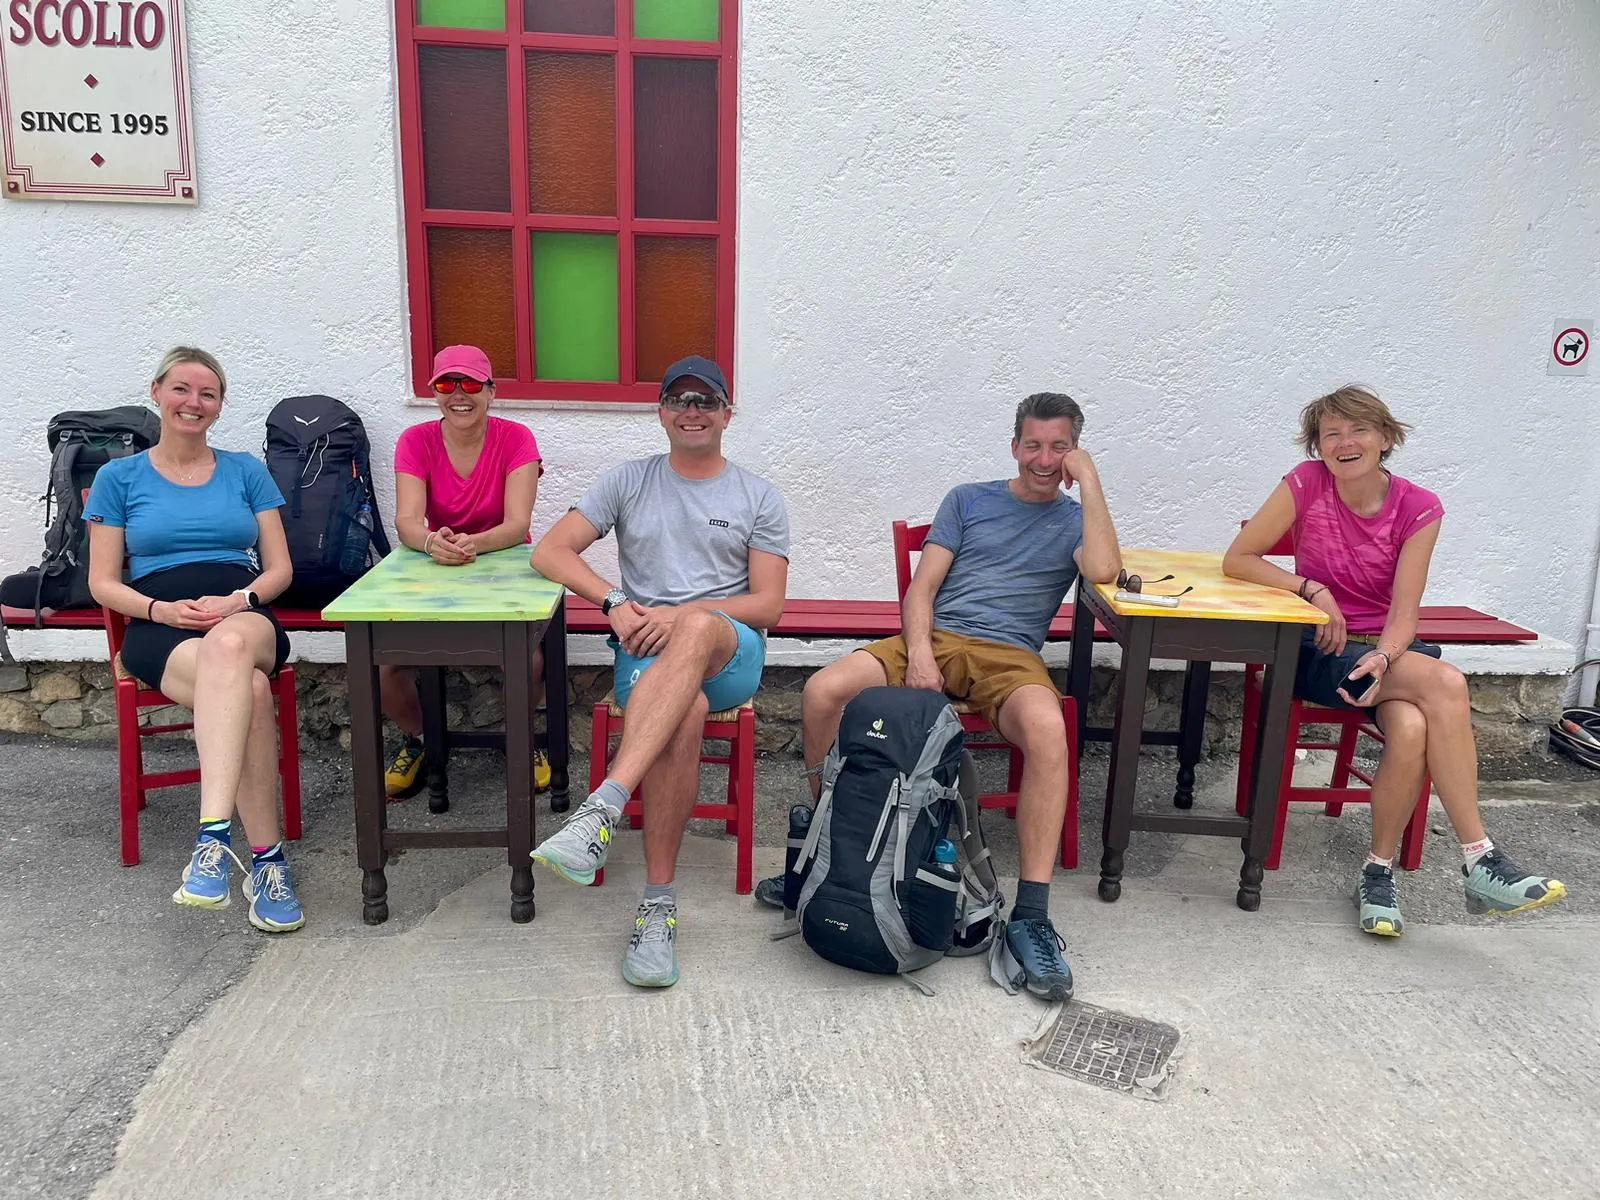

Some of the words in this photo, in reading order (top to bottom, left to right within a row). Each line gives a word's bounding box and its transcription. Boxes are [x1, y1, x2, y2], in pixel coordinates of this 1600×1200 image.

[9, 0, 166, 49] SCOLIO
[20, 111, 102, 133] SINCE
[110, 114, 169, 136] 1995
